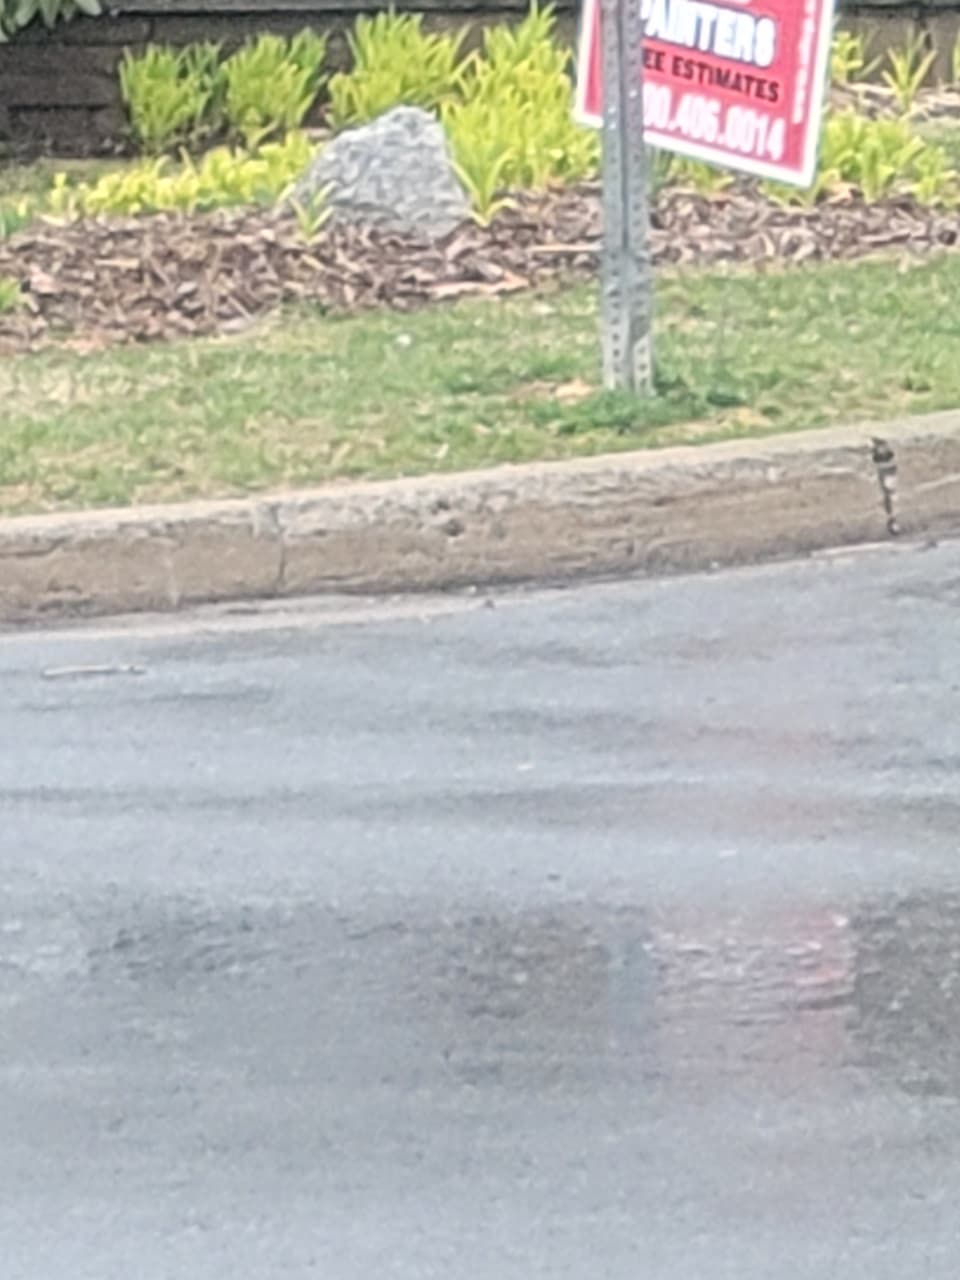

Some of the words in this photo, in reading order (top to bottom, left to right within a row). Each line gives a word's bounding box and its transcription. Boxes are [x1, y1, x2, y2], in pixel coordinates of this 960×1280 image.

[643, 48, 665, 70] EE
[672, 56, 779, 102] ESTIMATES
[643, 82, 786, 161] 00.406.0014
